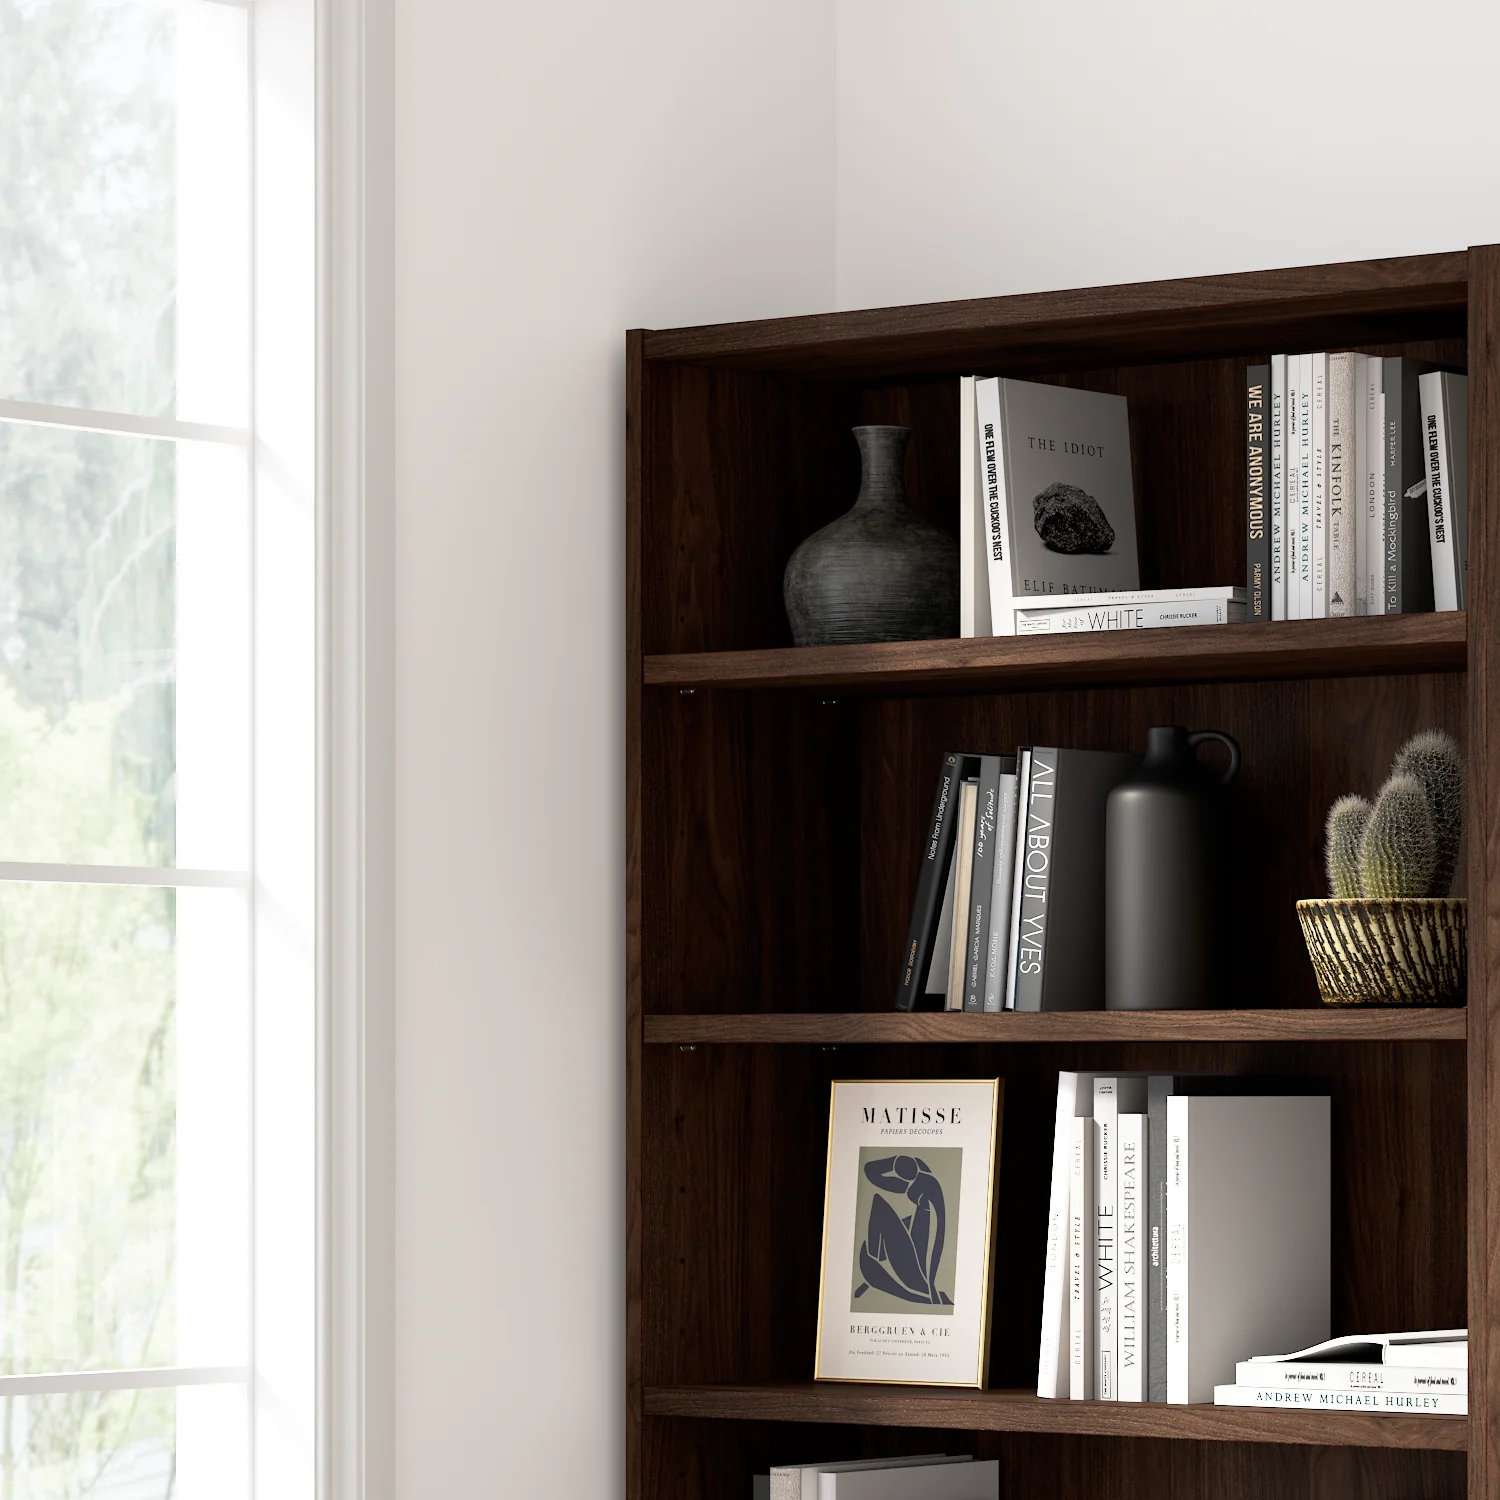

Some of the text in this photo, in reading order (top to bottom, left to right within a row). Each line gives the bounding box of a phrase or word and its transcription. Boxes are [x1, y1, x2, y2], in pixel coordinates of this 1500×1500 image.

[1028, 437, 1104, 458] THE IDIOT
[1248, 384, 1264, 540] WE ARE ANONYMOUS
[984, 423, 1003, 560] ONE FLEW OVER THE CUCKOO'S NEST
[1024, 580, 1054, 592] ELIF
[1254, 563, 1262, 616] PARMY OLSON
[1088, 609, 1143, 630] WHITE
[978, 814, 987, 840] years
[984, 788, 994, 832] of Solitude
[1020, 758, 1054, 975] ALL ABOUT YVES
[861, 1107, 962, 1124] MATISSE
[1074, 1139, 1082, 1176] CEREAL
[1098, 1206, 1114, 1292] WHITE
[1124, 1142, 1136, 1368] WILLIAM SHAKESPEARE
[1151, 1226, 1160, 1267] architettura
[1170, 1224, 1181, 1264] CEREAL
[850, 1325, 950, 1336] BERGGRUEN & CIE
[1350, 1372, 1383, 1384] CEREAL
[1256, 1392, 1440, 1408] ANDREW MICHAEL HURLEY
